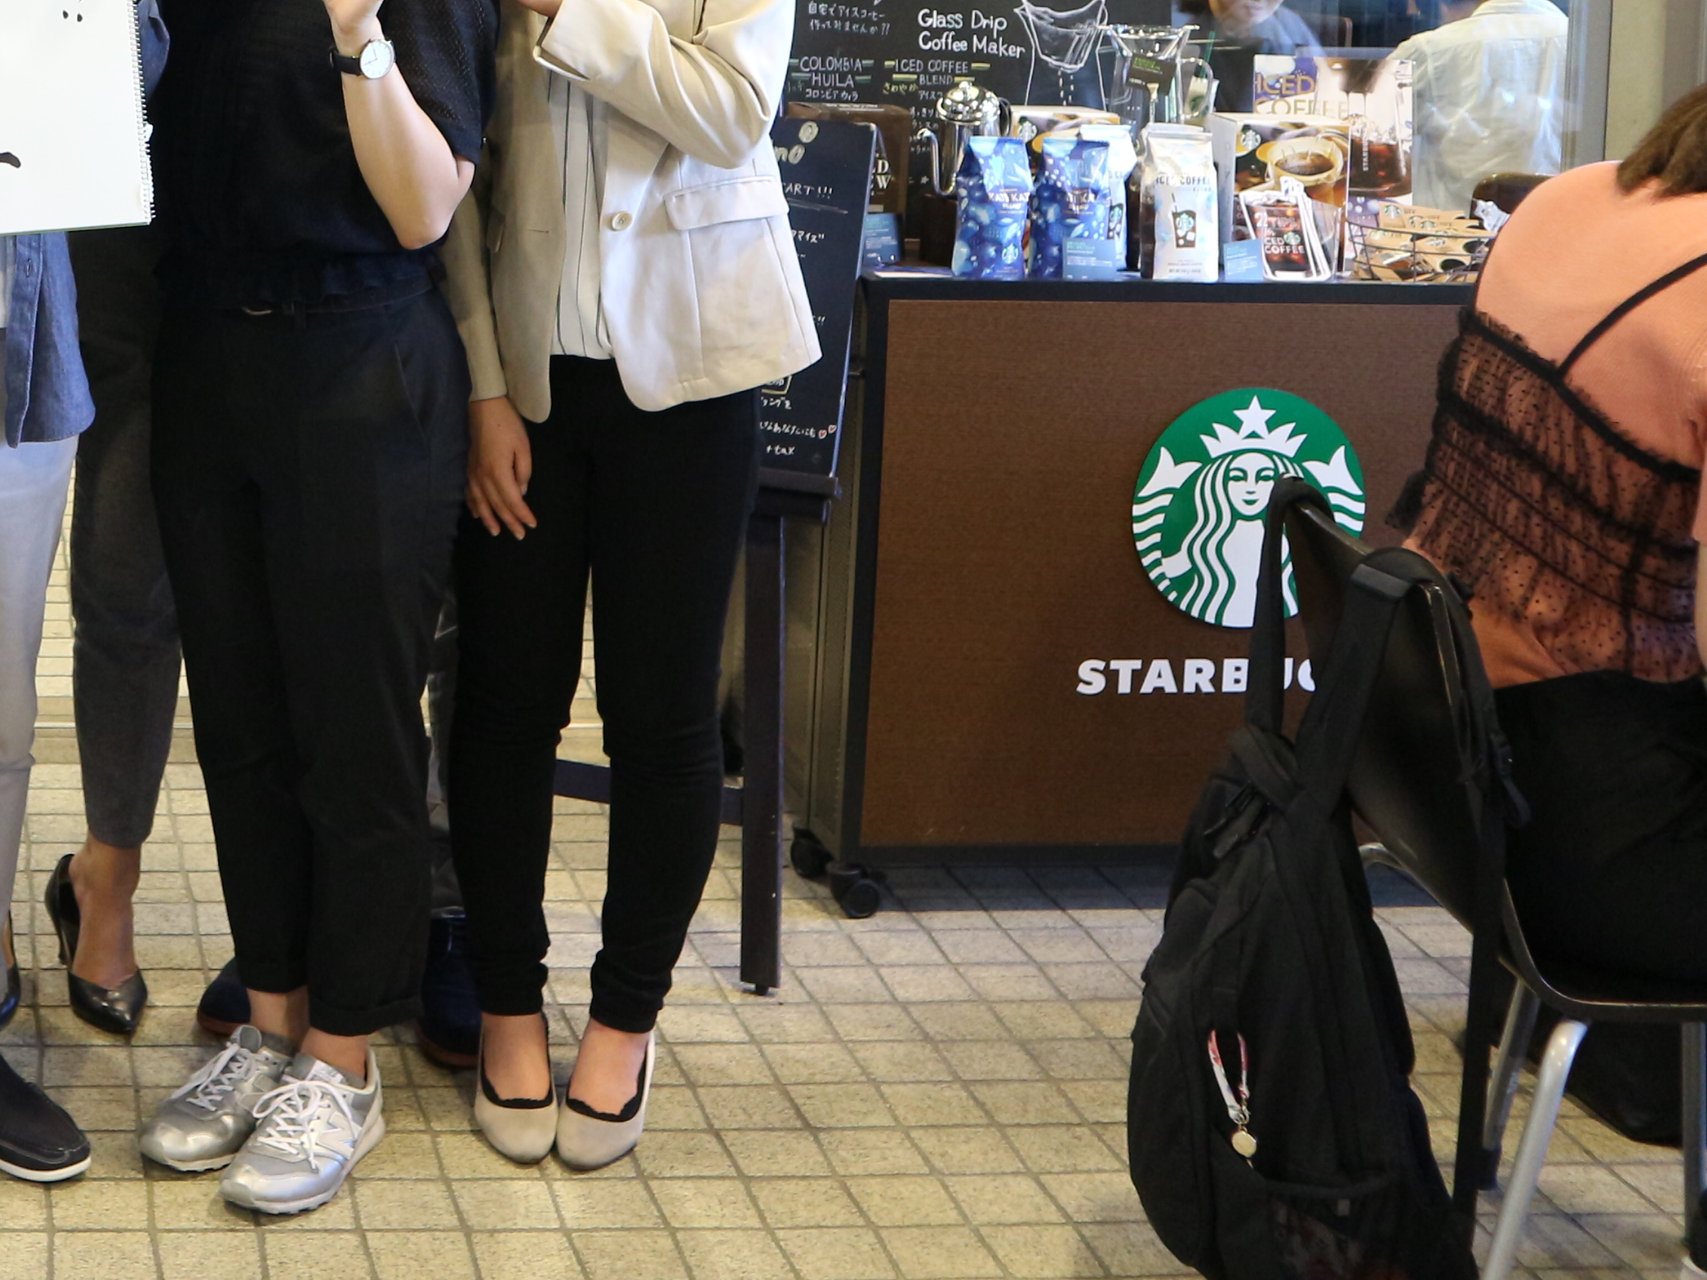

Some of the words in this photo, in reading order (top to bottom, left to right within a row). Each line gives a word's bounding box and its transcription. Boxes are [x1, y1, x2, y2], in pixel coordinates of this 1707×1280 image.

[917, 8, 963, 29] Glass
[971, 9, 1007, 38] Drip
[918, 32, 968, 53] Coffee
[972, 35, 1026, 58] Maker
[800, 57, 863, 72] COLOMBIA
[895, 59, 924, 72] ICED
[927, 60, 969, 74] COFFEE
[811, 72, 855, 88] HUILA
[919, 74, 953, 86] BLEND
[1256, 73, 1315, 95] ICED
[1264, 245, 1305, 254] COFFEE
